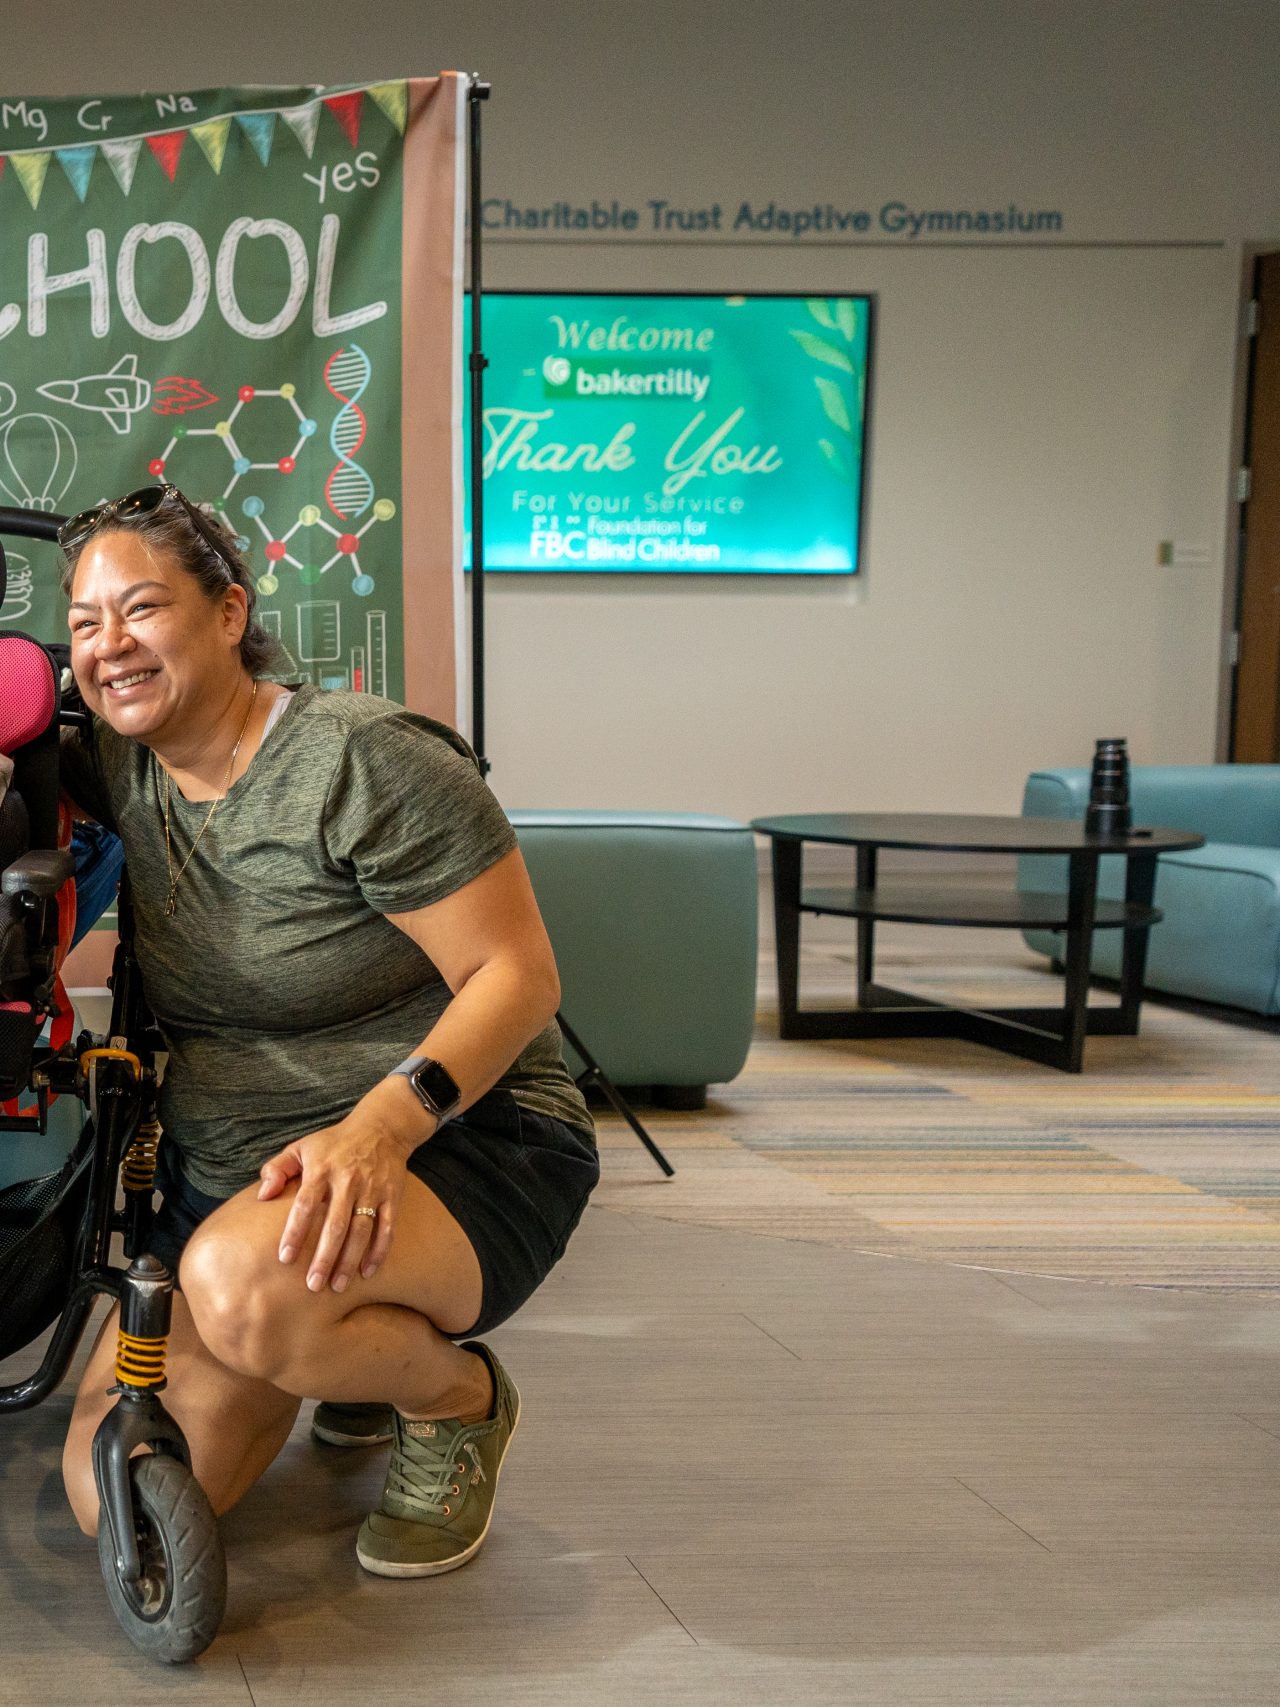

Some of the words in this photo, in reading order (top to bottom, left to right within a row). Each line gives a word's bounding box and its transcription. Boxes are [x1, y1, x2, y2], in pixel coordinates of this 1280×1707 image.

[2, 101, 49, 141] Mg
[77, 100, 112, 131] Cr
[155, 94, 198, 118] Na
[480, 198, 640, 230] Charitable
[647, 199, 722, 231] Trust
[733, 201, 870, 238] Adaptive
[879, 201, 1064, 239] Gymnasium
[548, 315, 716, 353] Welcome
[576, 367, 712, 403] bakertilly
[482, 406, 637, 480] Thank
[661, 405, 783, 497] You
[512, 490, 557, 513] For
[568, 491, 633, 514] Your
[644, 491, 746, 515] Service
[587, 515, 682, 536] Foundation
[683, 513, 708, 536] for
[530, 531, 587, 560] FBC
[586, 537, 636, 561] Blind
[637, 536, 721, 562] Children
